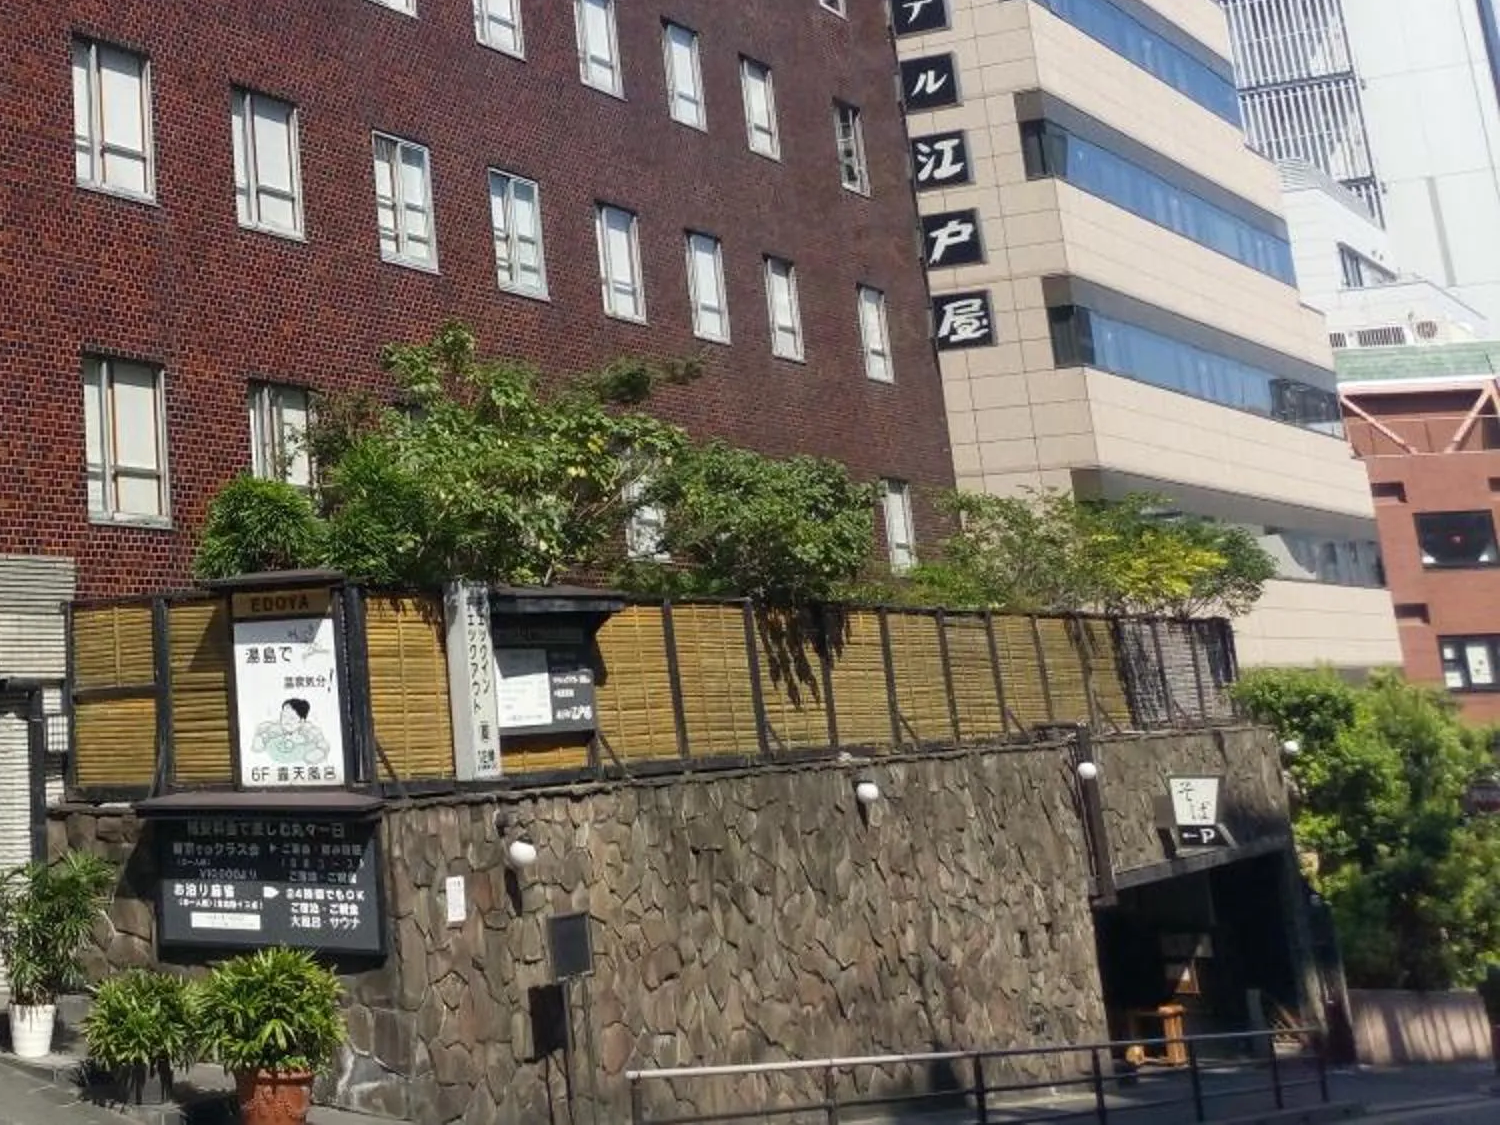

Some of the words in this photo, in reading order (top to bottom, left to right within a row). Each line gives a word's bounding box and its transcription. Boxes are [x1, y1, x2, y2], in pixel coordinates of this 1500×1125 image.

[250, 597, 309, 613] EDOYA
[245, 646, 293, 664] 湯島で
[251, 766, 271, 782] 6F
[277, 766, 337, 782] 露天風呂
[1199, 828, 1215, 844] P
